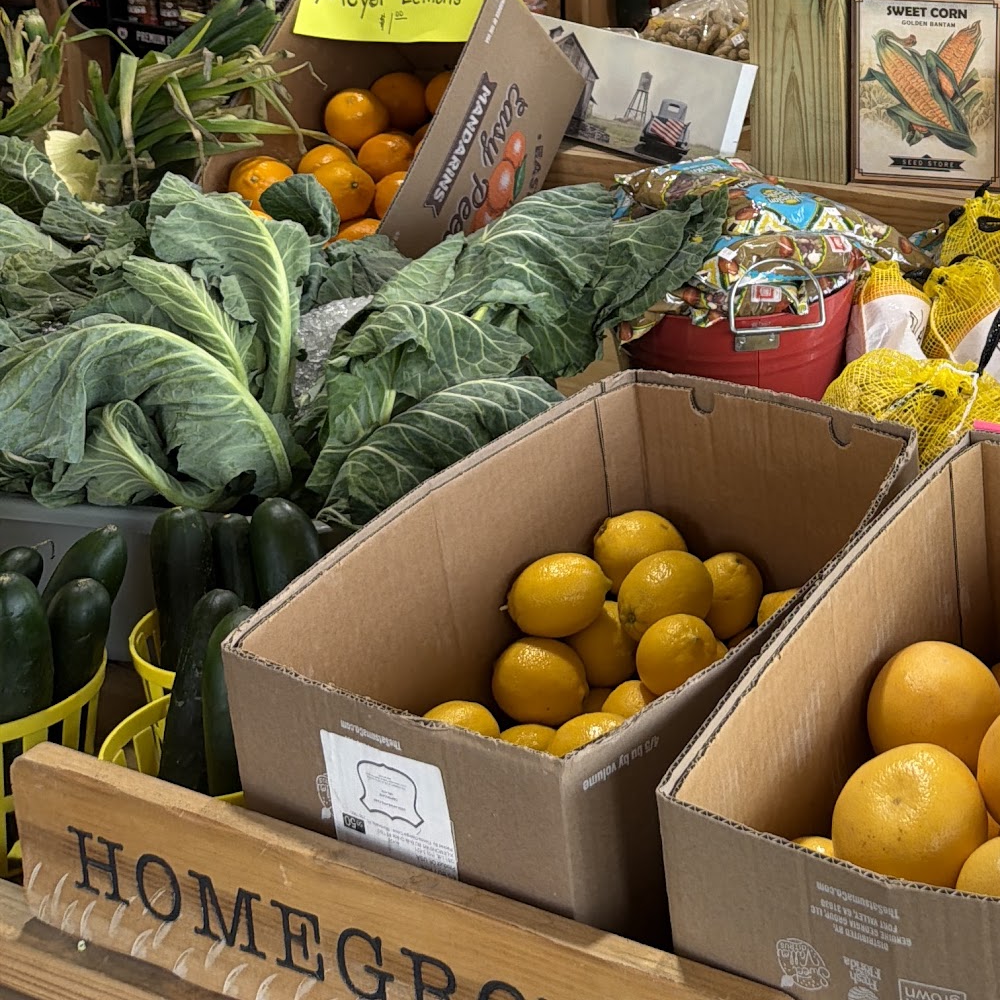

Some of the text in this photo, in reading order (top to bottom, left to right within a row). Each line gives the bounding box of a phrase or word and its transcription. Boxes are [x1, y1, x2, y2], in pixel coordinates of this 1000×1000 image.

[886, 5, 968, 19] SWEET CORN
[901, 19, 928, 27] GOLDEN
[135, 30, 166, 46] PREMIUM
[433, 82, 529, 204] MANDARINS Easy
[901, 158, 955, 168] SEED STORE
[339, 718, 403, 752] TheSatsumaCo.com
[582, 734, 660, 791] 4/5 bu by volume
[815, 880, 900, 920] TheSatsumaCo.com
[66, 824, 548, 1000] HOMEGR
[848, 920, 879, 938] GEORGIA
[878, 920, 898, 933] FORT
[844, 927, 889, 952] DISTRIBUTED
[880, 930, 912, 947] GENUINE
[791, 964, 830, 988] Sweet
[842, 955, 881, 980] Florida
[848, 971, 879, 992] Fresh
